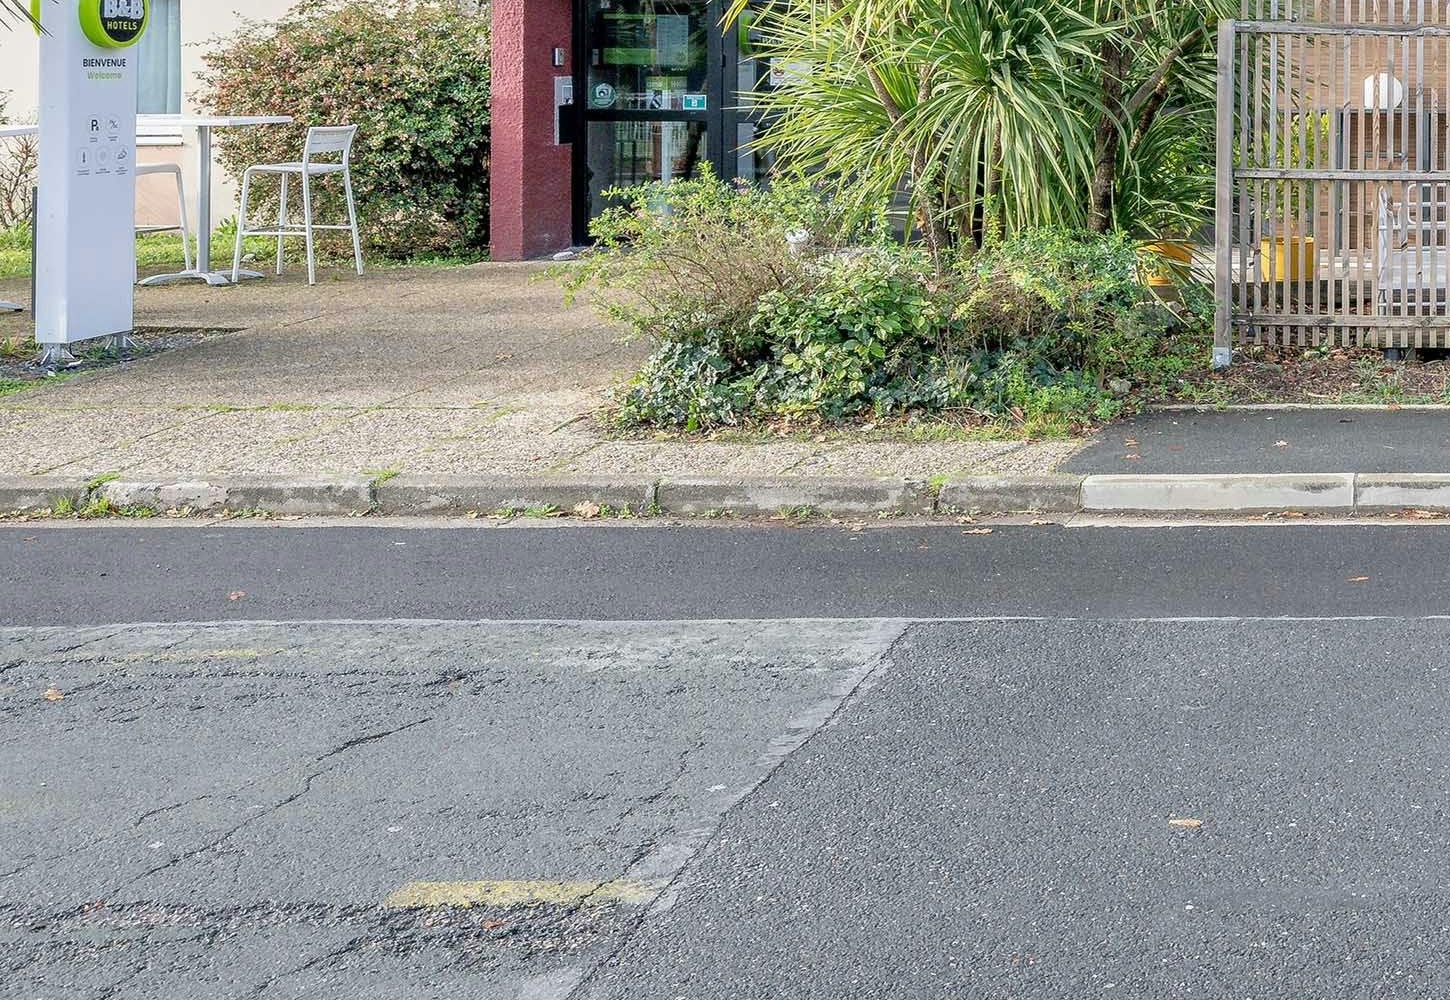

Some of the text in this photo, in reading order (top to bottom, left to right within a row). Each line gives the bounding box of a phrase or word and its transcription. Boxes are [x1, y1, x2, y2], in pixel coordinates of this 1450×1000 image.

[107, 21, 138, 30] HOTELS
[82, 58, 127, 68] BIENVENUE
[87, 71, 122, 80] Welcome
